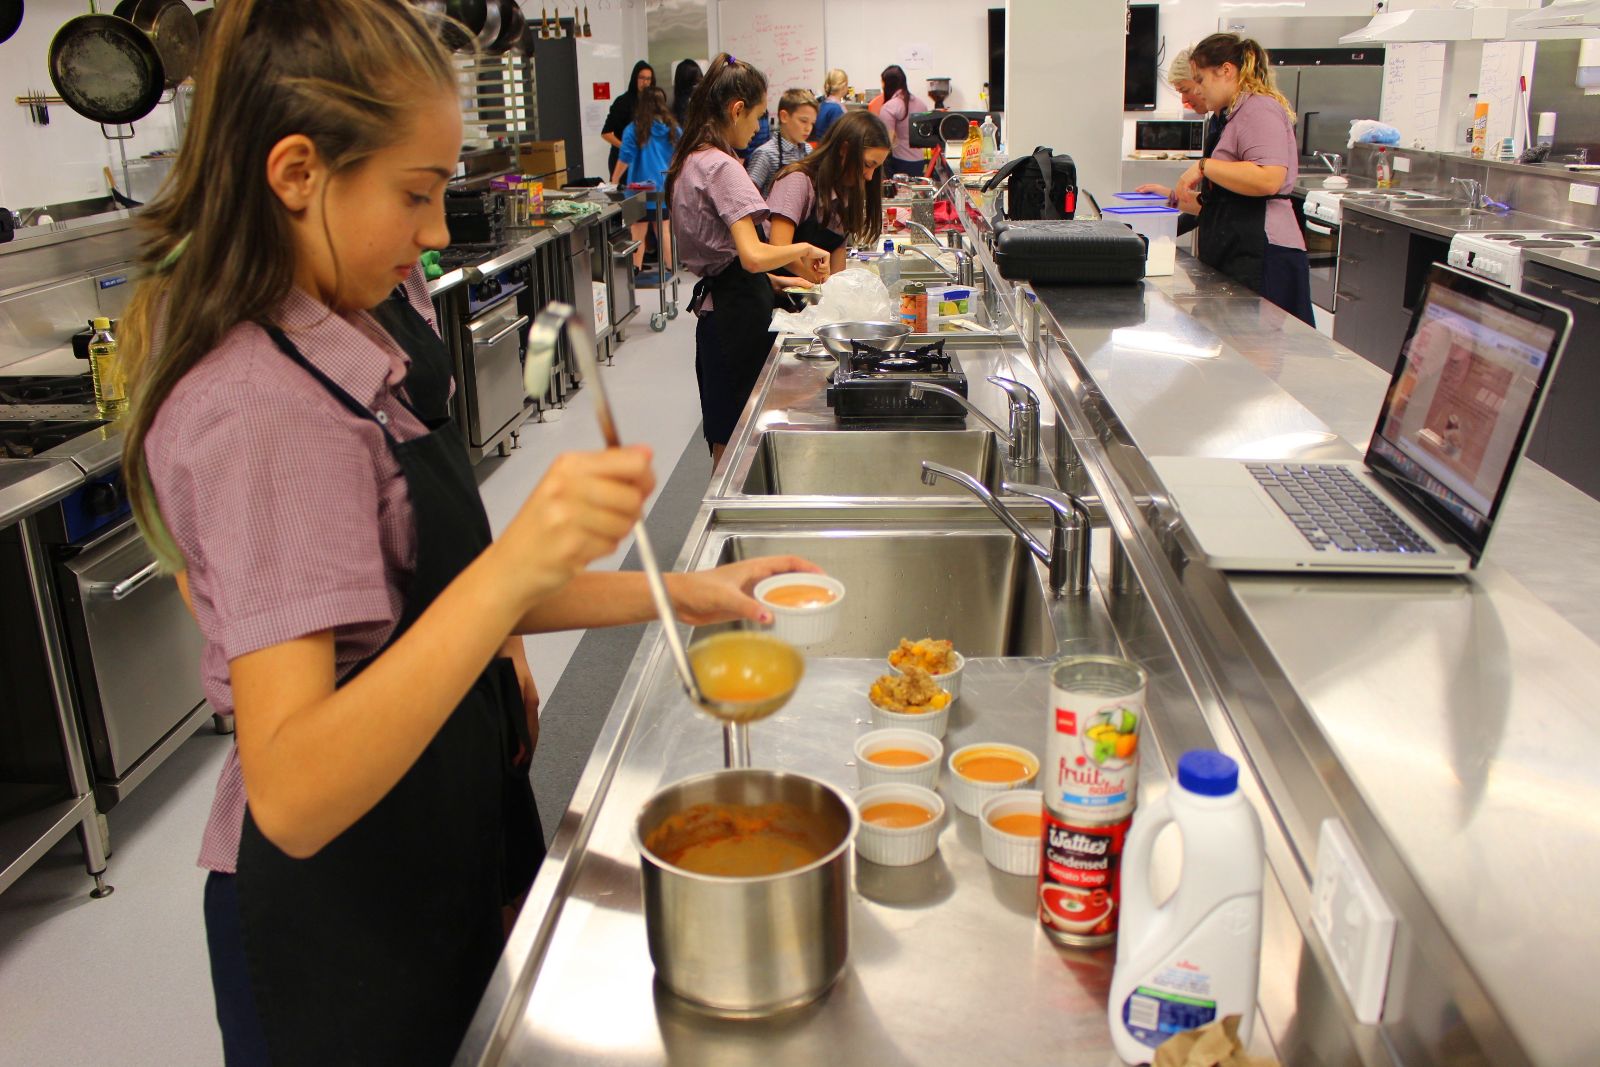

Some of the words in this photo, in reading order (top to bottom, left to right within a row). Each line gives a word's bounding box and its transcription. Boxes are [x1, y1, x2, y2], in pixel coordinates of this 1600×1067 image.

[1059, 757, 1103, 786] fruit
[1047, 848, 1108, 871] Condensed
[1048, 862, 1079, 881] Tomato
[1081, 871, 1105, 884] Soup
